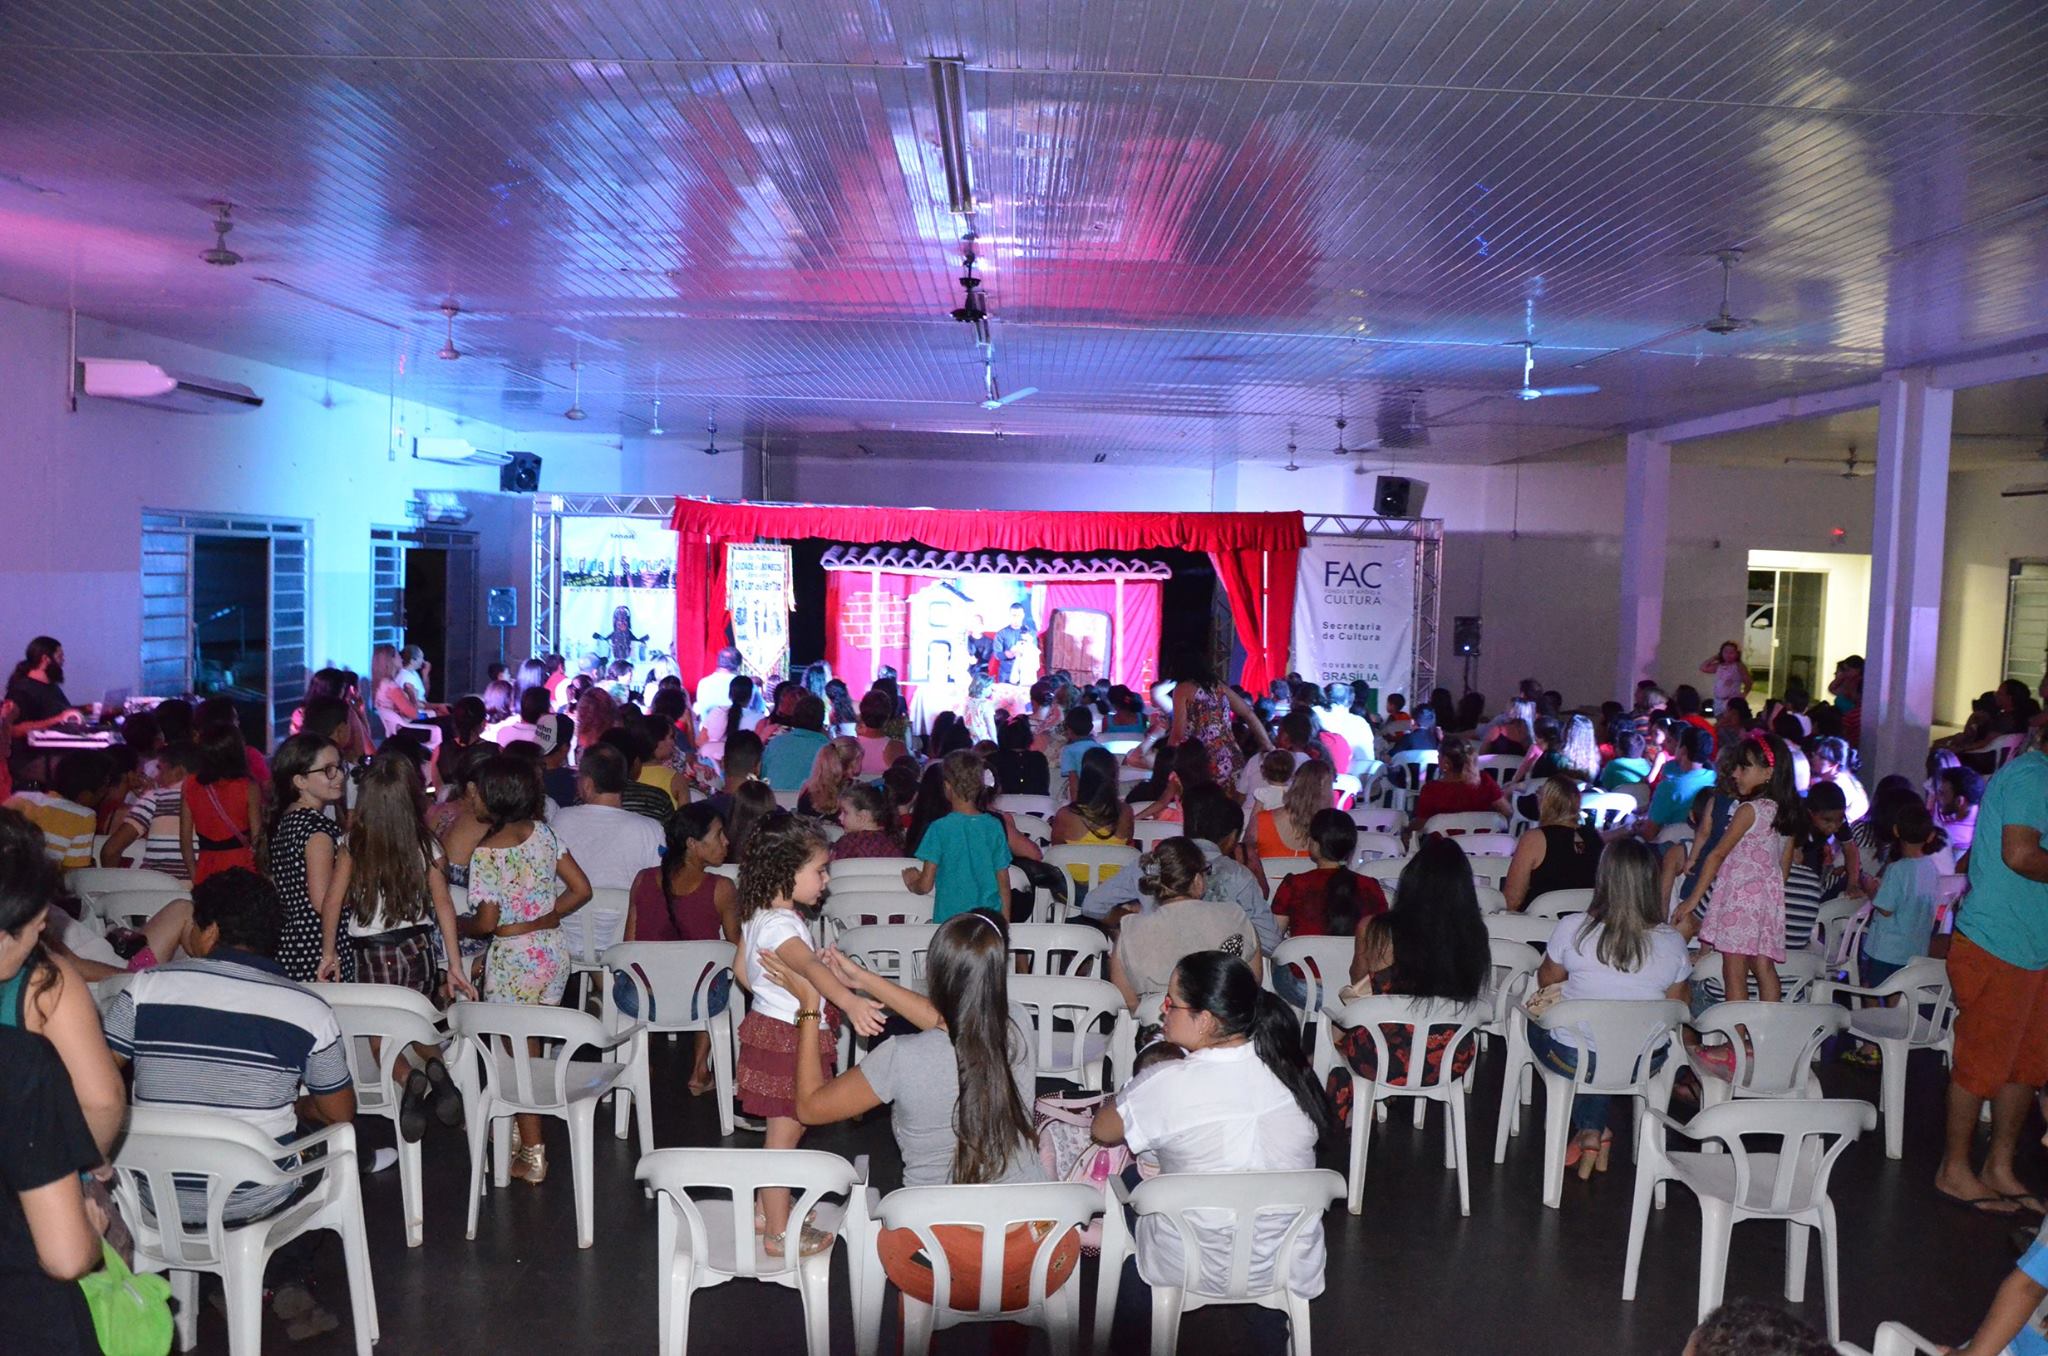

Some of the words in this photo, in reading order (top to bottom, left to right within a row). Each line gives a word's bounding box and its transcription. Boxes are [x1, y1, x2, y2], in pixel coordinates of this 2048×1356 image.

[1325, 561, 1382, 588] FAC
[1324, 594, 1382, 605] CULTURA
[1322, 621, 1382, 631] Secretaria
[1322, 632, 1335, 640] de
[1338, 632, 1381, 641] Cultura
